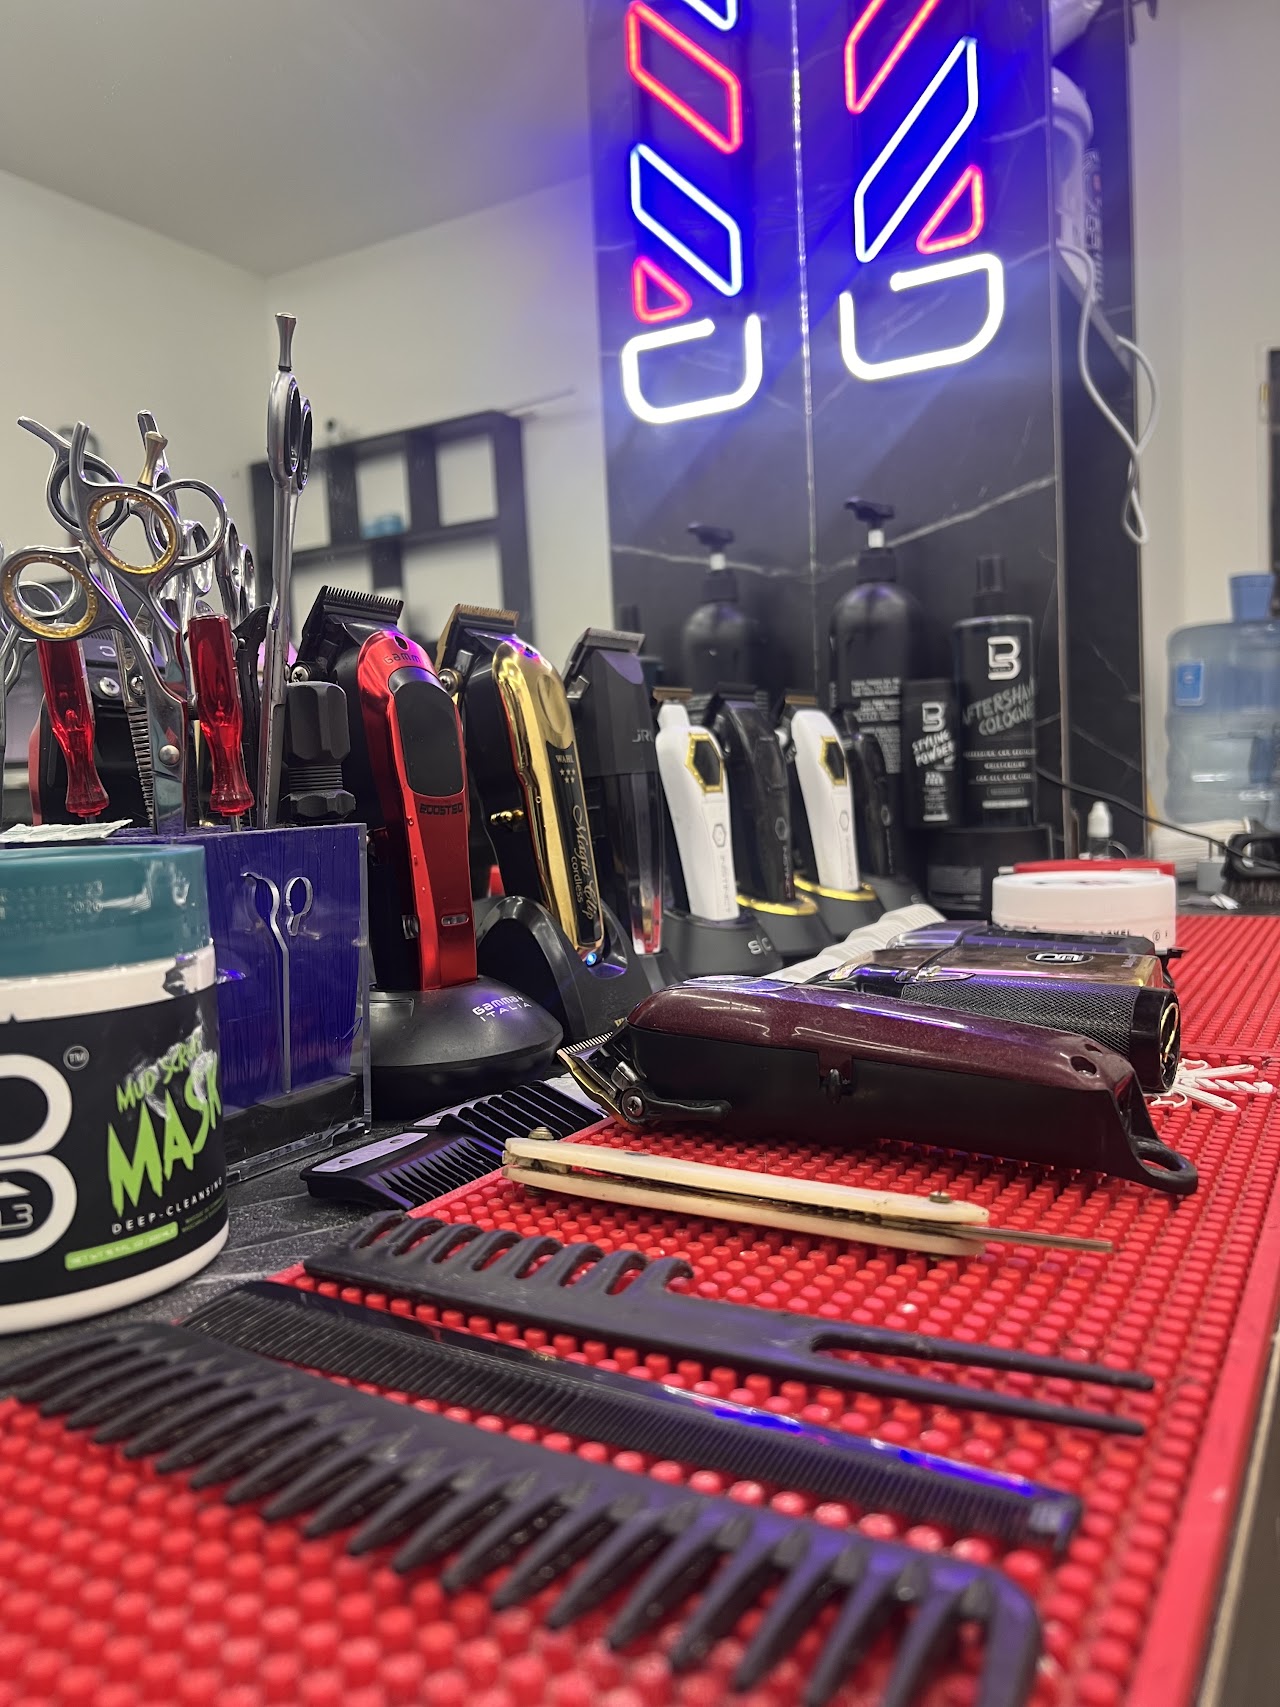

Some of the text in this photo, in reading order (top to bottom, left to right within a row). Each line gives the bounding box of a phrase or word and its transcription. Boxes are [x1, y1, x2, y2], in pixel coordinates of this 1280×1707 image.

[555, 755, 575, 763] WAHL
[420, 803, 464, 815] BOOSTED
[570, 856, 584, 903] cordless
[480, 1002, 532, 1022] ITALIA
[116, 1070, 158, 1113] MUD
[112, 1177, 223, 1235] DEEP-CLEANSING
